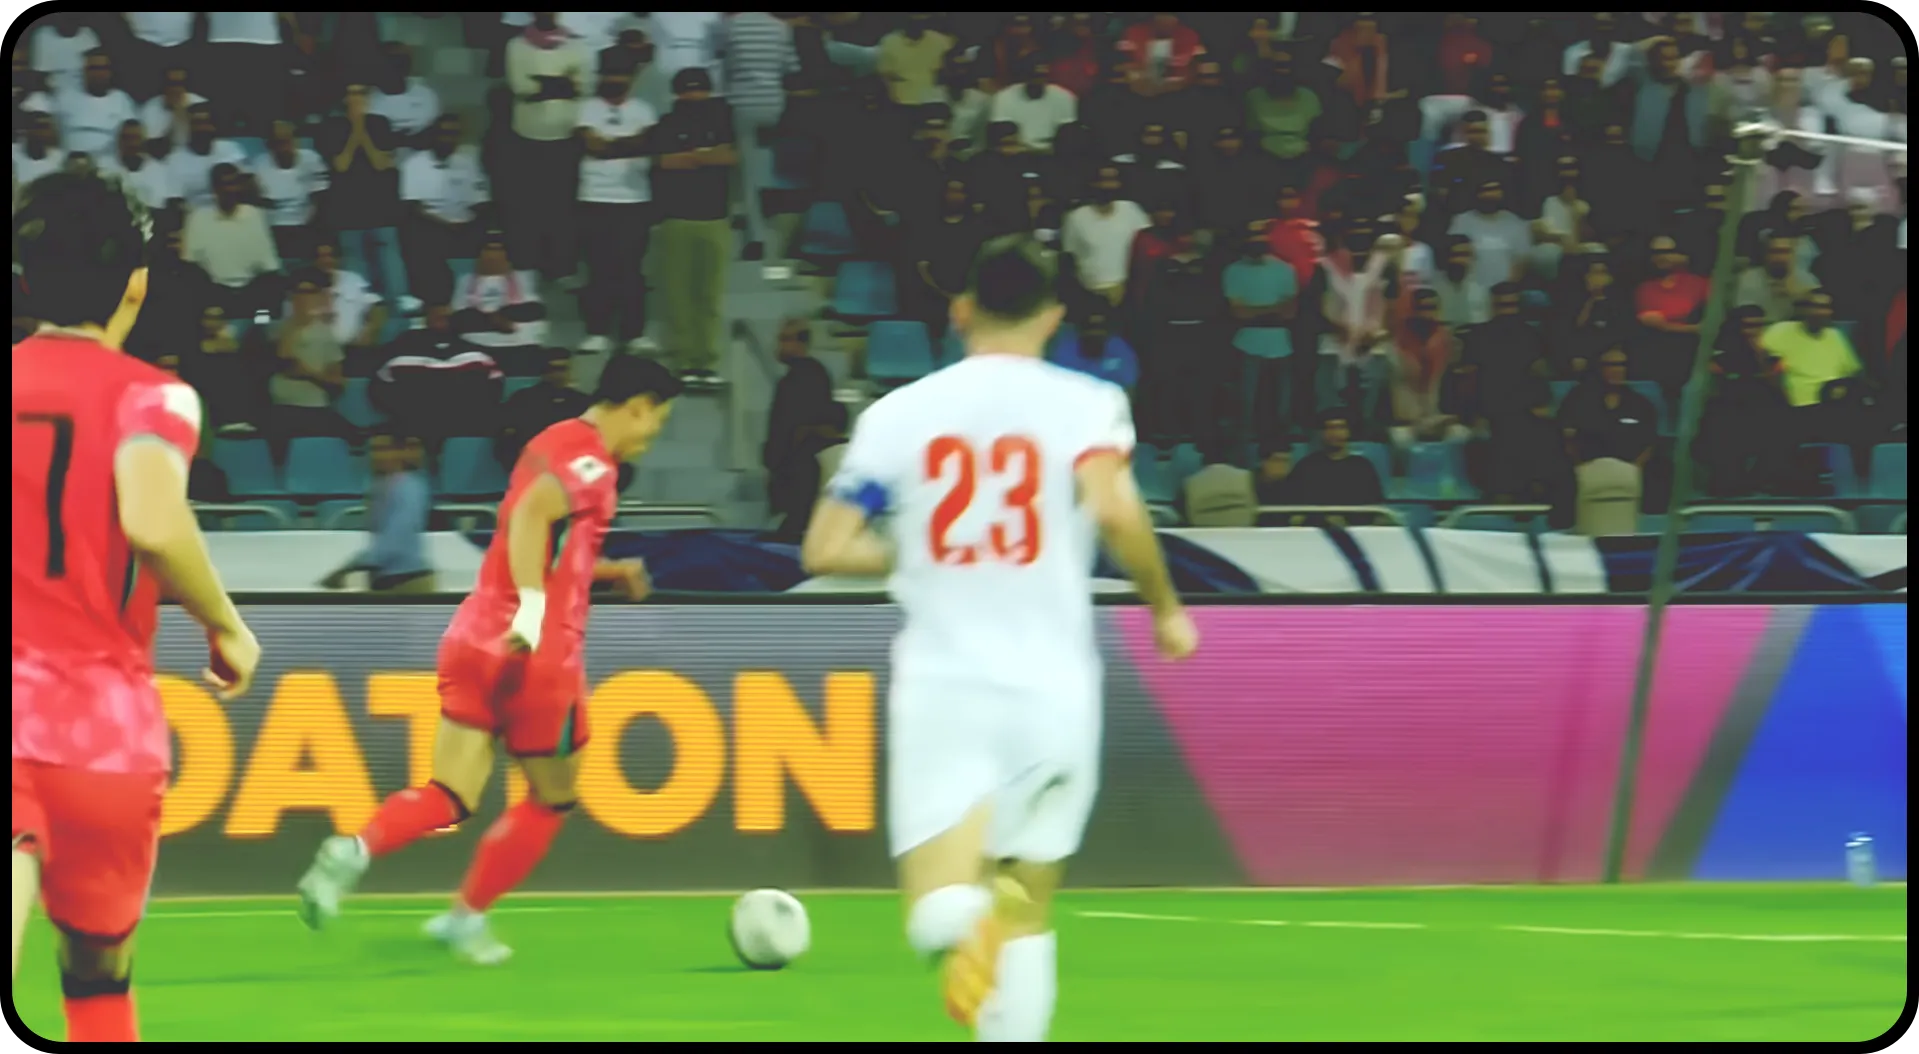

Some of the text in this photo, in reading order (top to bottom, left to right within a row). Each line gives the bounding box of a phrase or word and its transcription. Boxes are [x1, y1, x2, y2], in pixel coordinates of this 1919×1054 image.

[17, 412, 74, 578] 7
[926, 435, 1041, 566] 23
[153, 670, 876, 837] DATON
